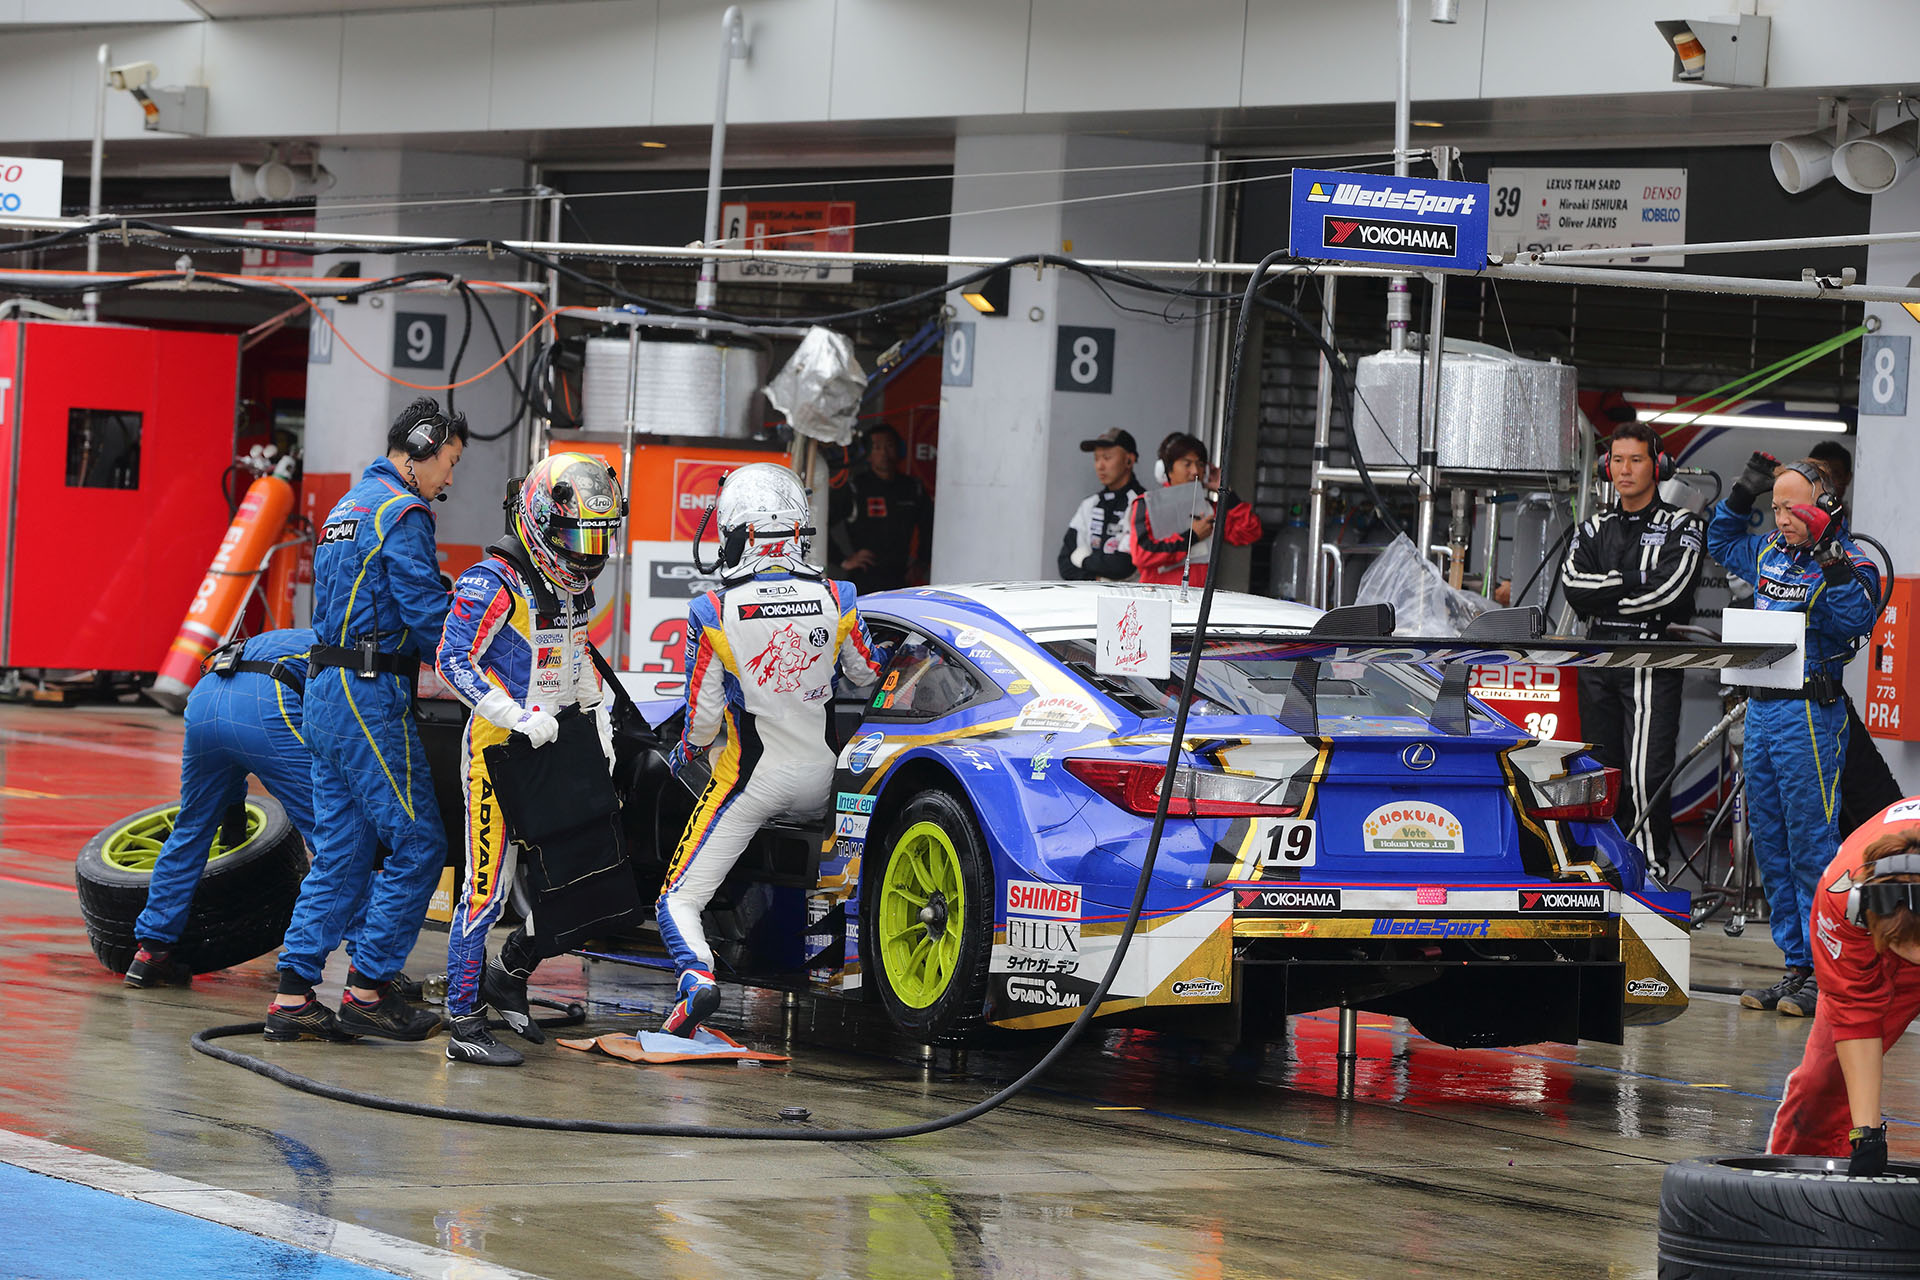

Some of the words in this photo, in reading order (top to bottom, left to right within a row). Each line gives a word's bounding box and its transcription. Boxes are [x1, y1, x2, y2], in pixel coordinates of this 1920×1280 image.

[1547, 179, 1571, 189] LEXUS
[1574, 180, 1596, 190] TEAM
[1599, 181, 1620, 190] SARD
[1642, 186, 1682, 200] DENSO
[1331, 183, 1476, 215] WedsSport
[1495, 187, 1521, 217] 39
[1559, 199, 1589, 210] Hiroaki
[1591, 200, 1628, 210] ISHIURA
[1558, 217, 1584, 228] Oliver
[1586, 217, 1617, 228] JARVIS
[1641, 208, 1680, 222] KOBELCO
[1358, 225, 1449, 249] YOKOHAMA
[406, 320, 432, 362] 9
[950, 329, 967, 377] 9
[1070, 335, 1099, 385] 8
[1872, 347, 1896, 404] 8
[760, 602, 819, 616] YOKOHAMA
[1881, 605, 1897, 675] 消火器
[968, 648, 992, 658] KTEL
[1470, 690, 1512, 699] ACING
[1876, 685, 1896, 699] 773
[1868, 702, 1900, 728] PR4
[1524, 712, 1558, 740] 39
[1379, 810, 1445, 827] HOKUAI
[477, 777, 493, 896] ADVAN
[1266, 824, 1313, 861] 19
[1381, 840, 1409, 848] Hokuai
[1009, 885, 1079, 913] SHIMBI
[1261, 892, 1336, 907] YOKOHAMA
[1542, 894, 1600, 907] YOKOHAMA
[1370, 918, 1491, 939] WedsSport
[1006, 955, 1079, 974] タイヤガーデン
